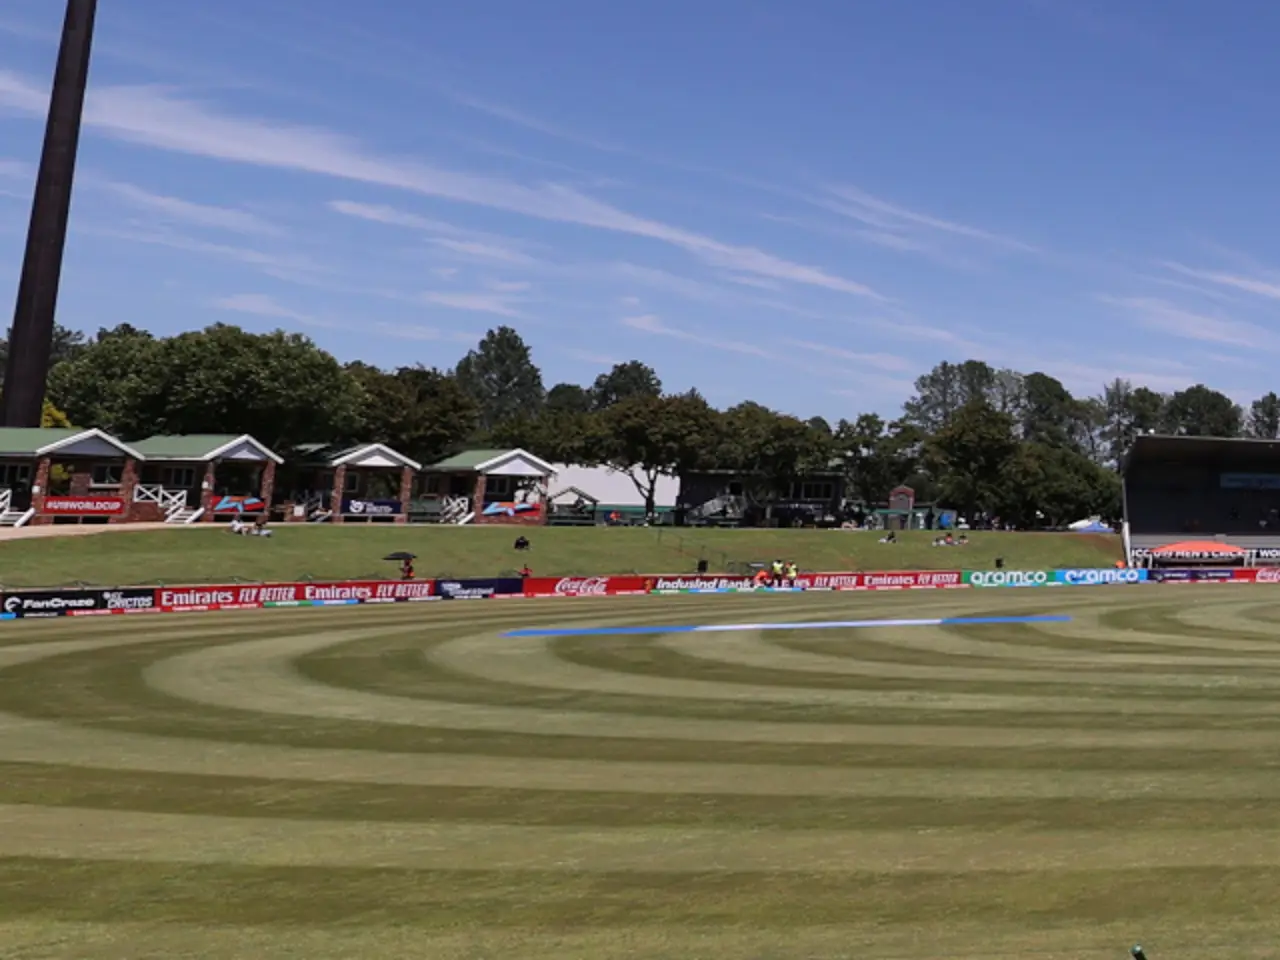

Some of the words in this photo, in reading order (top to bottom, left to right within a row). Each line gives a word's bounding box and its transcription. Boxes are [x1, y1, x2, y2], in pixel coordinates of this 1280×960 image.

[656, 577, 718, 590] IndusInd
[718, 578, 753, 590] Bank
[863, 575, 914, 586] Emirates
[970, 571, 1047, 586] aramco
[161, 590, 234, 607] Emirates
[238, 587, 259, 602] FLY
[259, 586, 297, 601] BETTER
[304, 585, 373, 600] Emirates
[375, 584, 395, 598] FLY
[395, 583, 430, 597] BETTER
[23, 597, 95, 610] FanCraze
